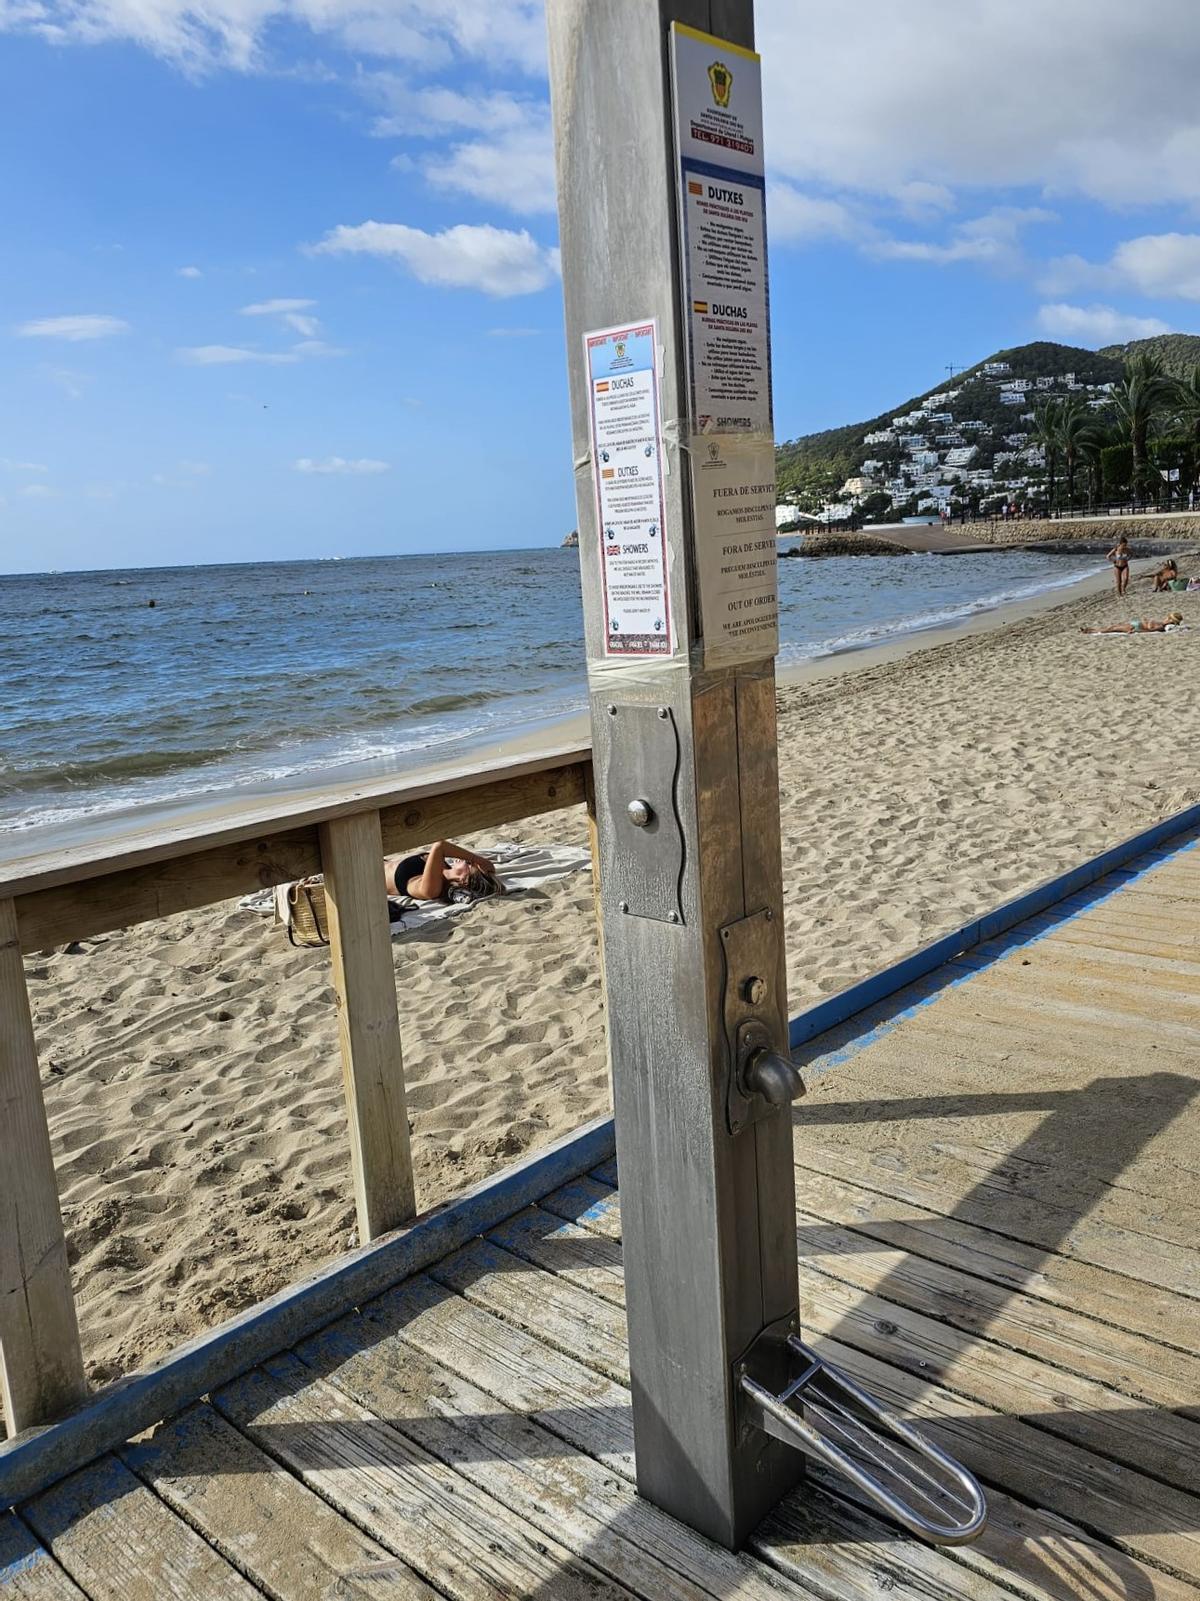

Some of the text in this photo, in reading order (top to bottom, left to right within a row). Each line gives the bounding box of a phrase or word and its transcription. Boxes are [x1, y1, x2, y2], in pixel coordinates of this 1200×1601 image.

[708, 186, 744, 205] DUTXES
[712, 303, 748, 319] DUCHAS
[611, 376, 634, 390] DUCHAS
[716, 416, 752, 428] SHOWERS
[617, 465, 639, 477] DUTXES
[713, 483, 775, 498] FUERA DE SERVICI
[717, 507, 743, 516] ROGAMOS
[622, 543, 649, 554] SHOWERS
[722, 545, 743, 556] FORA
[743, 542, 753, 552] DE
[727, 594, 776, 611] OUT OF ORDER
[732, 620, 742, 628] ARE
